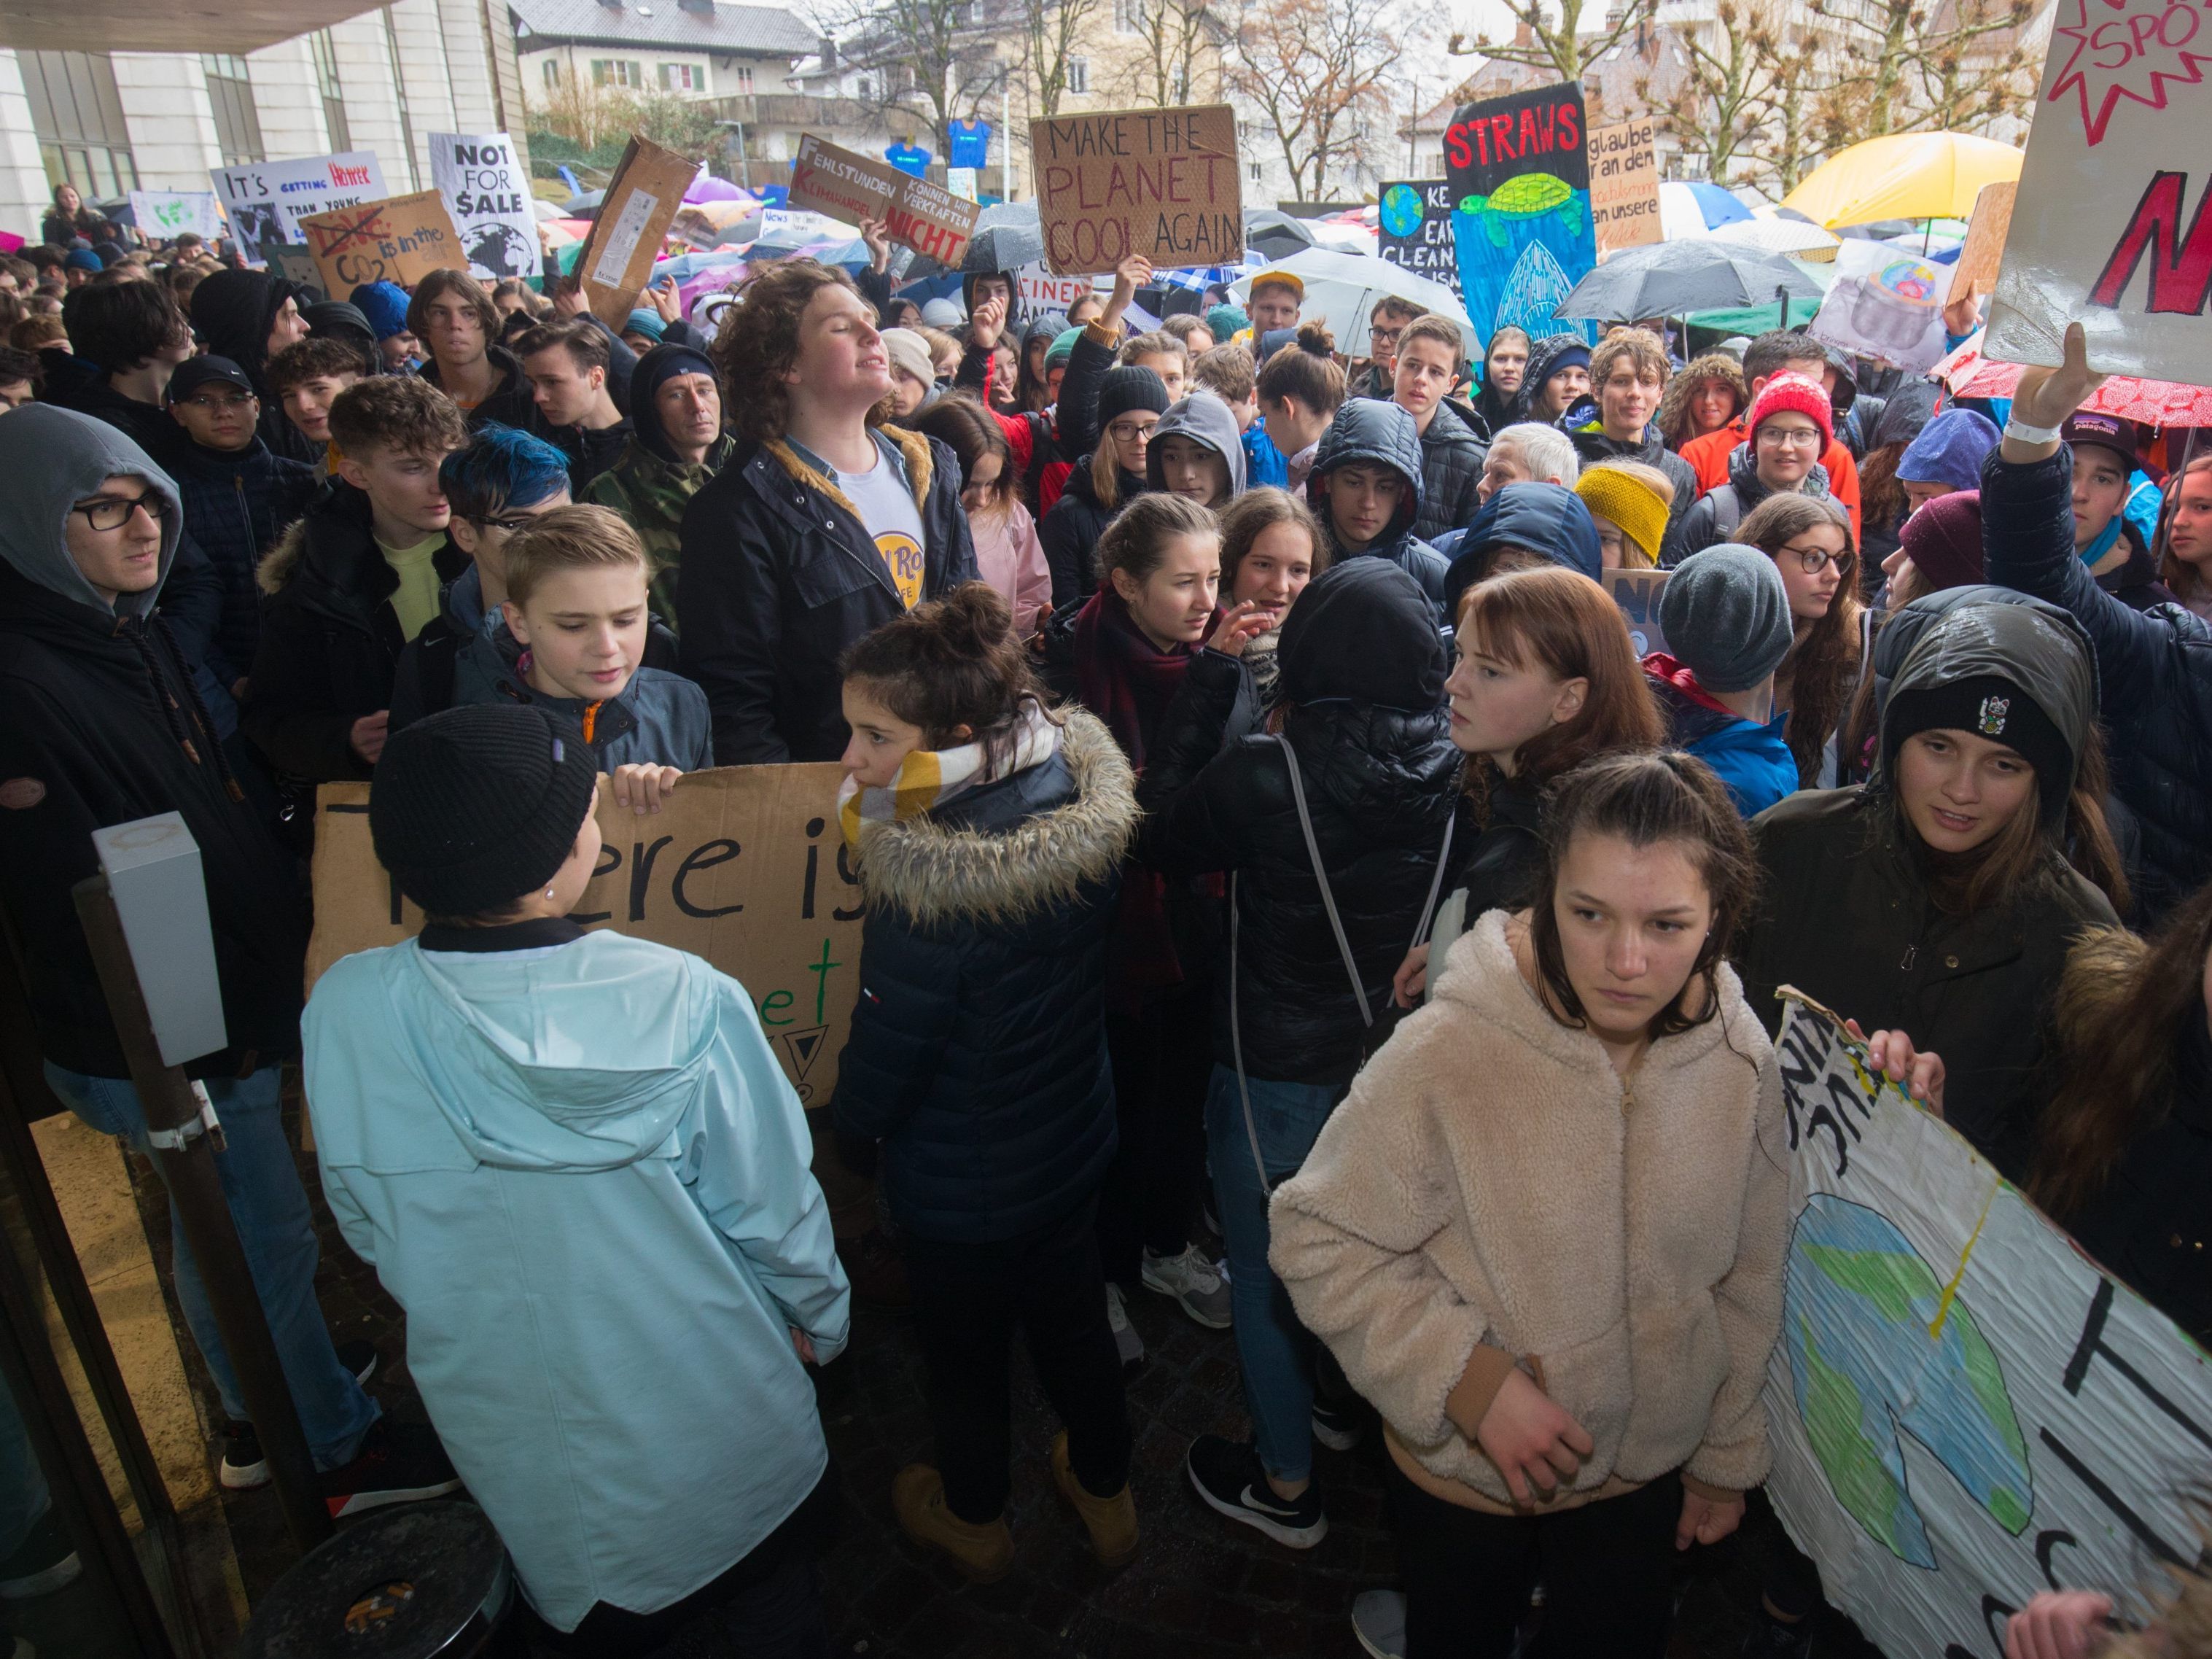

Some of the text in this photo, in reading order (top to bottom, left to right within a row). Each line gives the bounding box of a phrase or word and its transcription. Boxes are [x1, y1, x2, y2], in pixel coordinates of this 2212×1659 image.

[1048, 113, 1202, 160] MAKE THE
[1446, 103, 1579, 168] STRAWS
[1588, 123, 1653, 161] glaube
[454, 144, 510, 166] NOT
[800, 136, 896, 199] FEHLSTUNDEN
[1601, 157, 1619, 177] an
[1624, 148, 1654, 171] den
[225, 160, 371, 199] IT'S GETTING HOTTER
[465, 169, 511, 190] FOR
[908, 179, 951, 206] KÖNNEN
[954, 199, 972, 214] WIR
[1045, 151, 1226, 211] PLANET
[286, 196, 361, 217] THAN YOUNG
[456, 191, 523, 218] $ALE
[903, 192, 971, 230] VERKRAFTEN
[1612, 198, 1657, 219] unsere
[885, 205, 966, 263] NICHT
[1154, 211, 1242, 255] AGAIN
[2075, 423, 2116, 436] patagonia
[750, 938, 843, 1026] et
